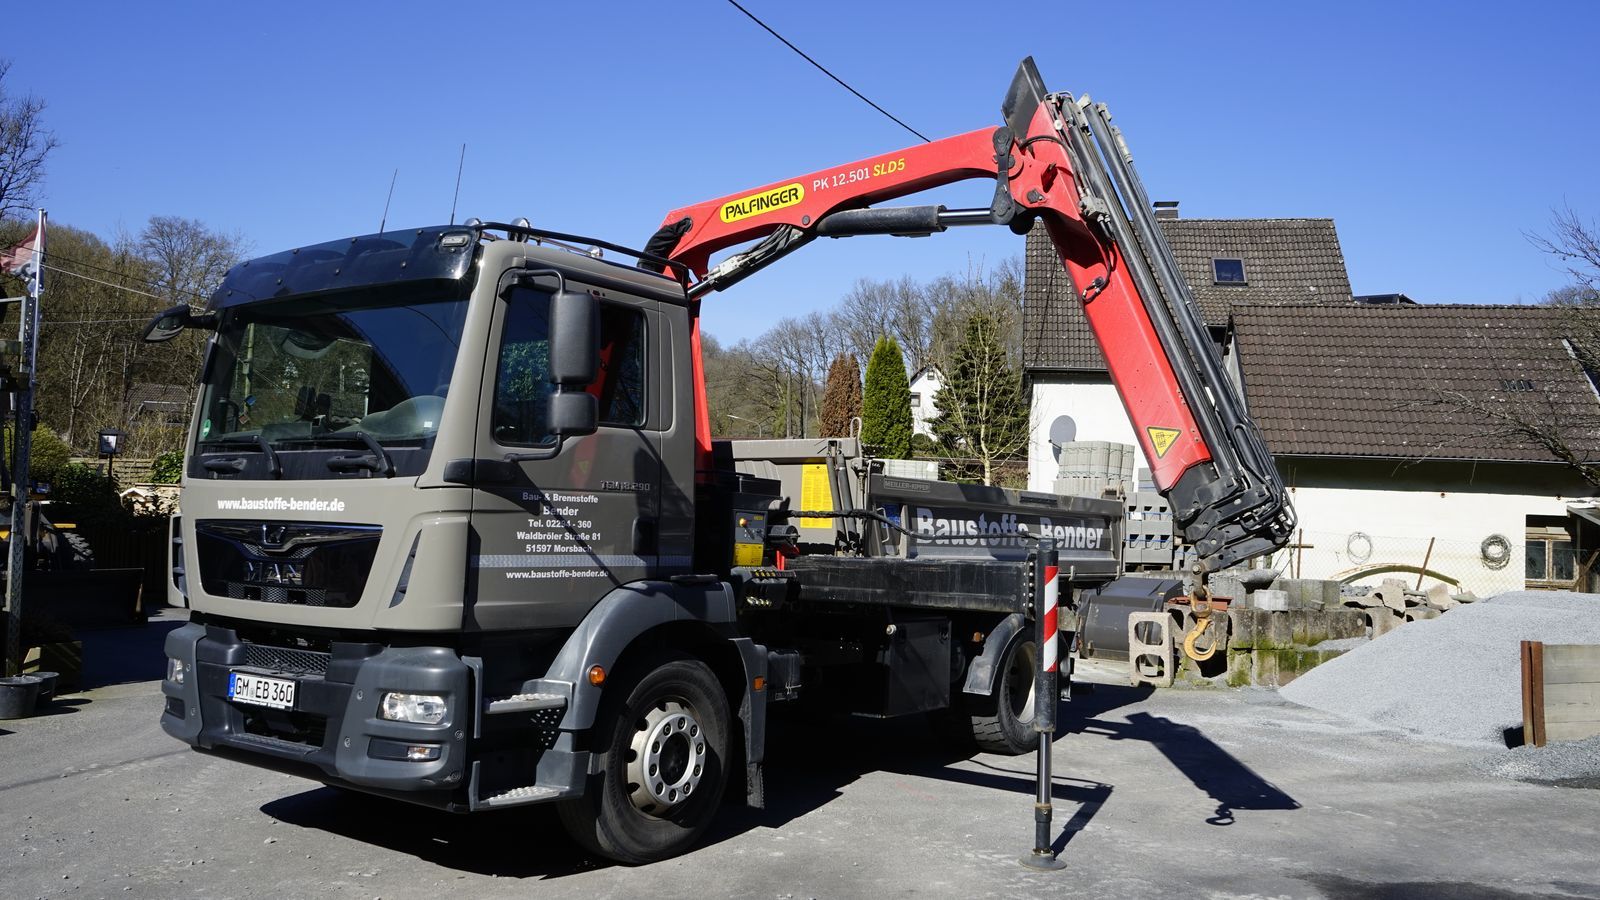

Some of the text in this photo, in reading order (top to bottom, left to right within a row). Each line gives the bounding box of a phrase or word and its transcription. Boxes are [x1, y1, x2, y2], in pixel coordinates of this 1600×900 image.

[812, 157, 906, 193] PK 12.501 SLD5
[724, 186, 800, 220] PALFINGER
[217, 497, 346, 512] www.baustoffe-bender.de
[522, 492, 599, 504] Bau- & Brennstoffe
[543, 505, 579, 516] Bender
[528, 519, 544, 528] Tel.
[546, 519, 571, 529] 02294
[577, 520, 592, 529] 360
[916, 507, 1029, 548] Baustoffe
[1039, 516, 1104, 549] Bender
[516, 531, 601, 541] Waldbröler Straße 81
[525, 544, 592, 553] 51597 Morsbach
[244, 561, 304, 586] MAN
[506, 569, 609, 579] www.baustoffe-bender.de
[235, 677, 293, 704] GM EB 360
